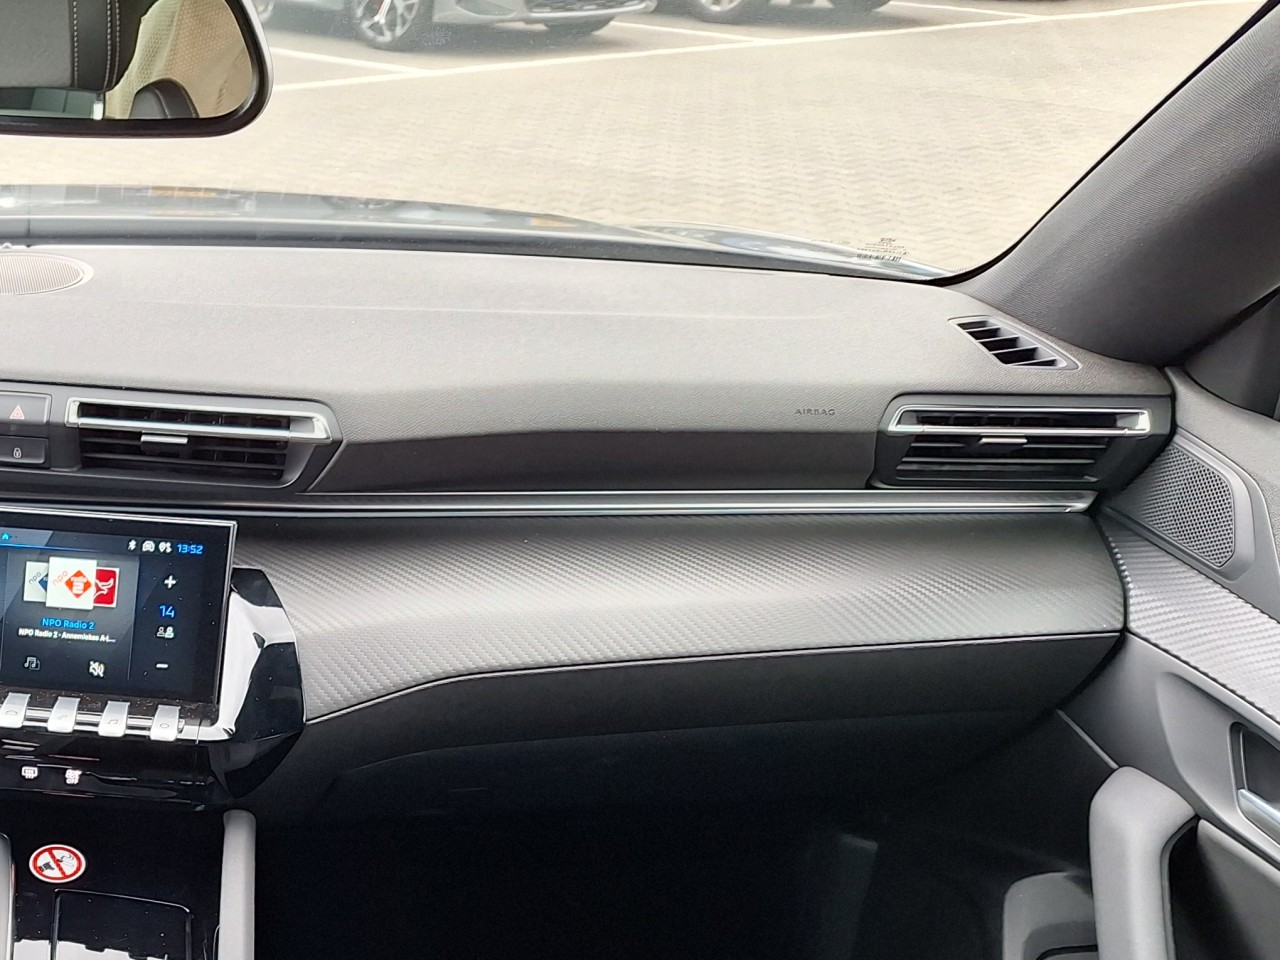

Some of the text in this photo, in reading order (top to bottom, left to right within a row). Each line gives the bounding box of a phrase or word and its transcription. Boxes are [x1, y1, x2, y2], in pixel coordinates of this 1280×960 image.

[794, 408, 836, 416] AIRBAG
[177, 543, 203, 555] 13:52
[71, 581, 85, 595] 2
[159, 604, 175, 619] 14
[42, 617, 95, 630] NPO Radio 2
[18, 628, 34, 637] NPO
[34, 629, 53, 638] Radio
